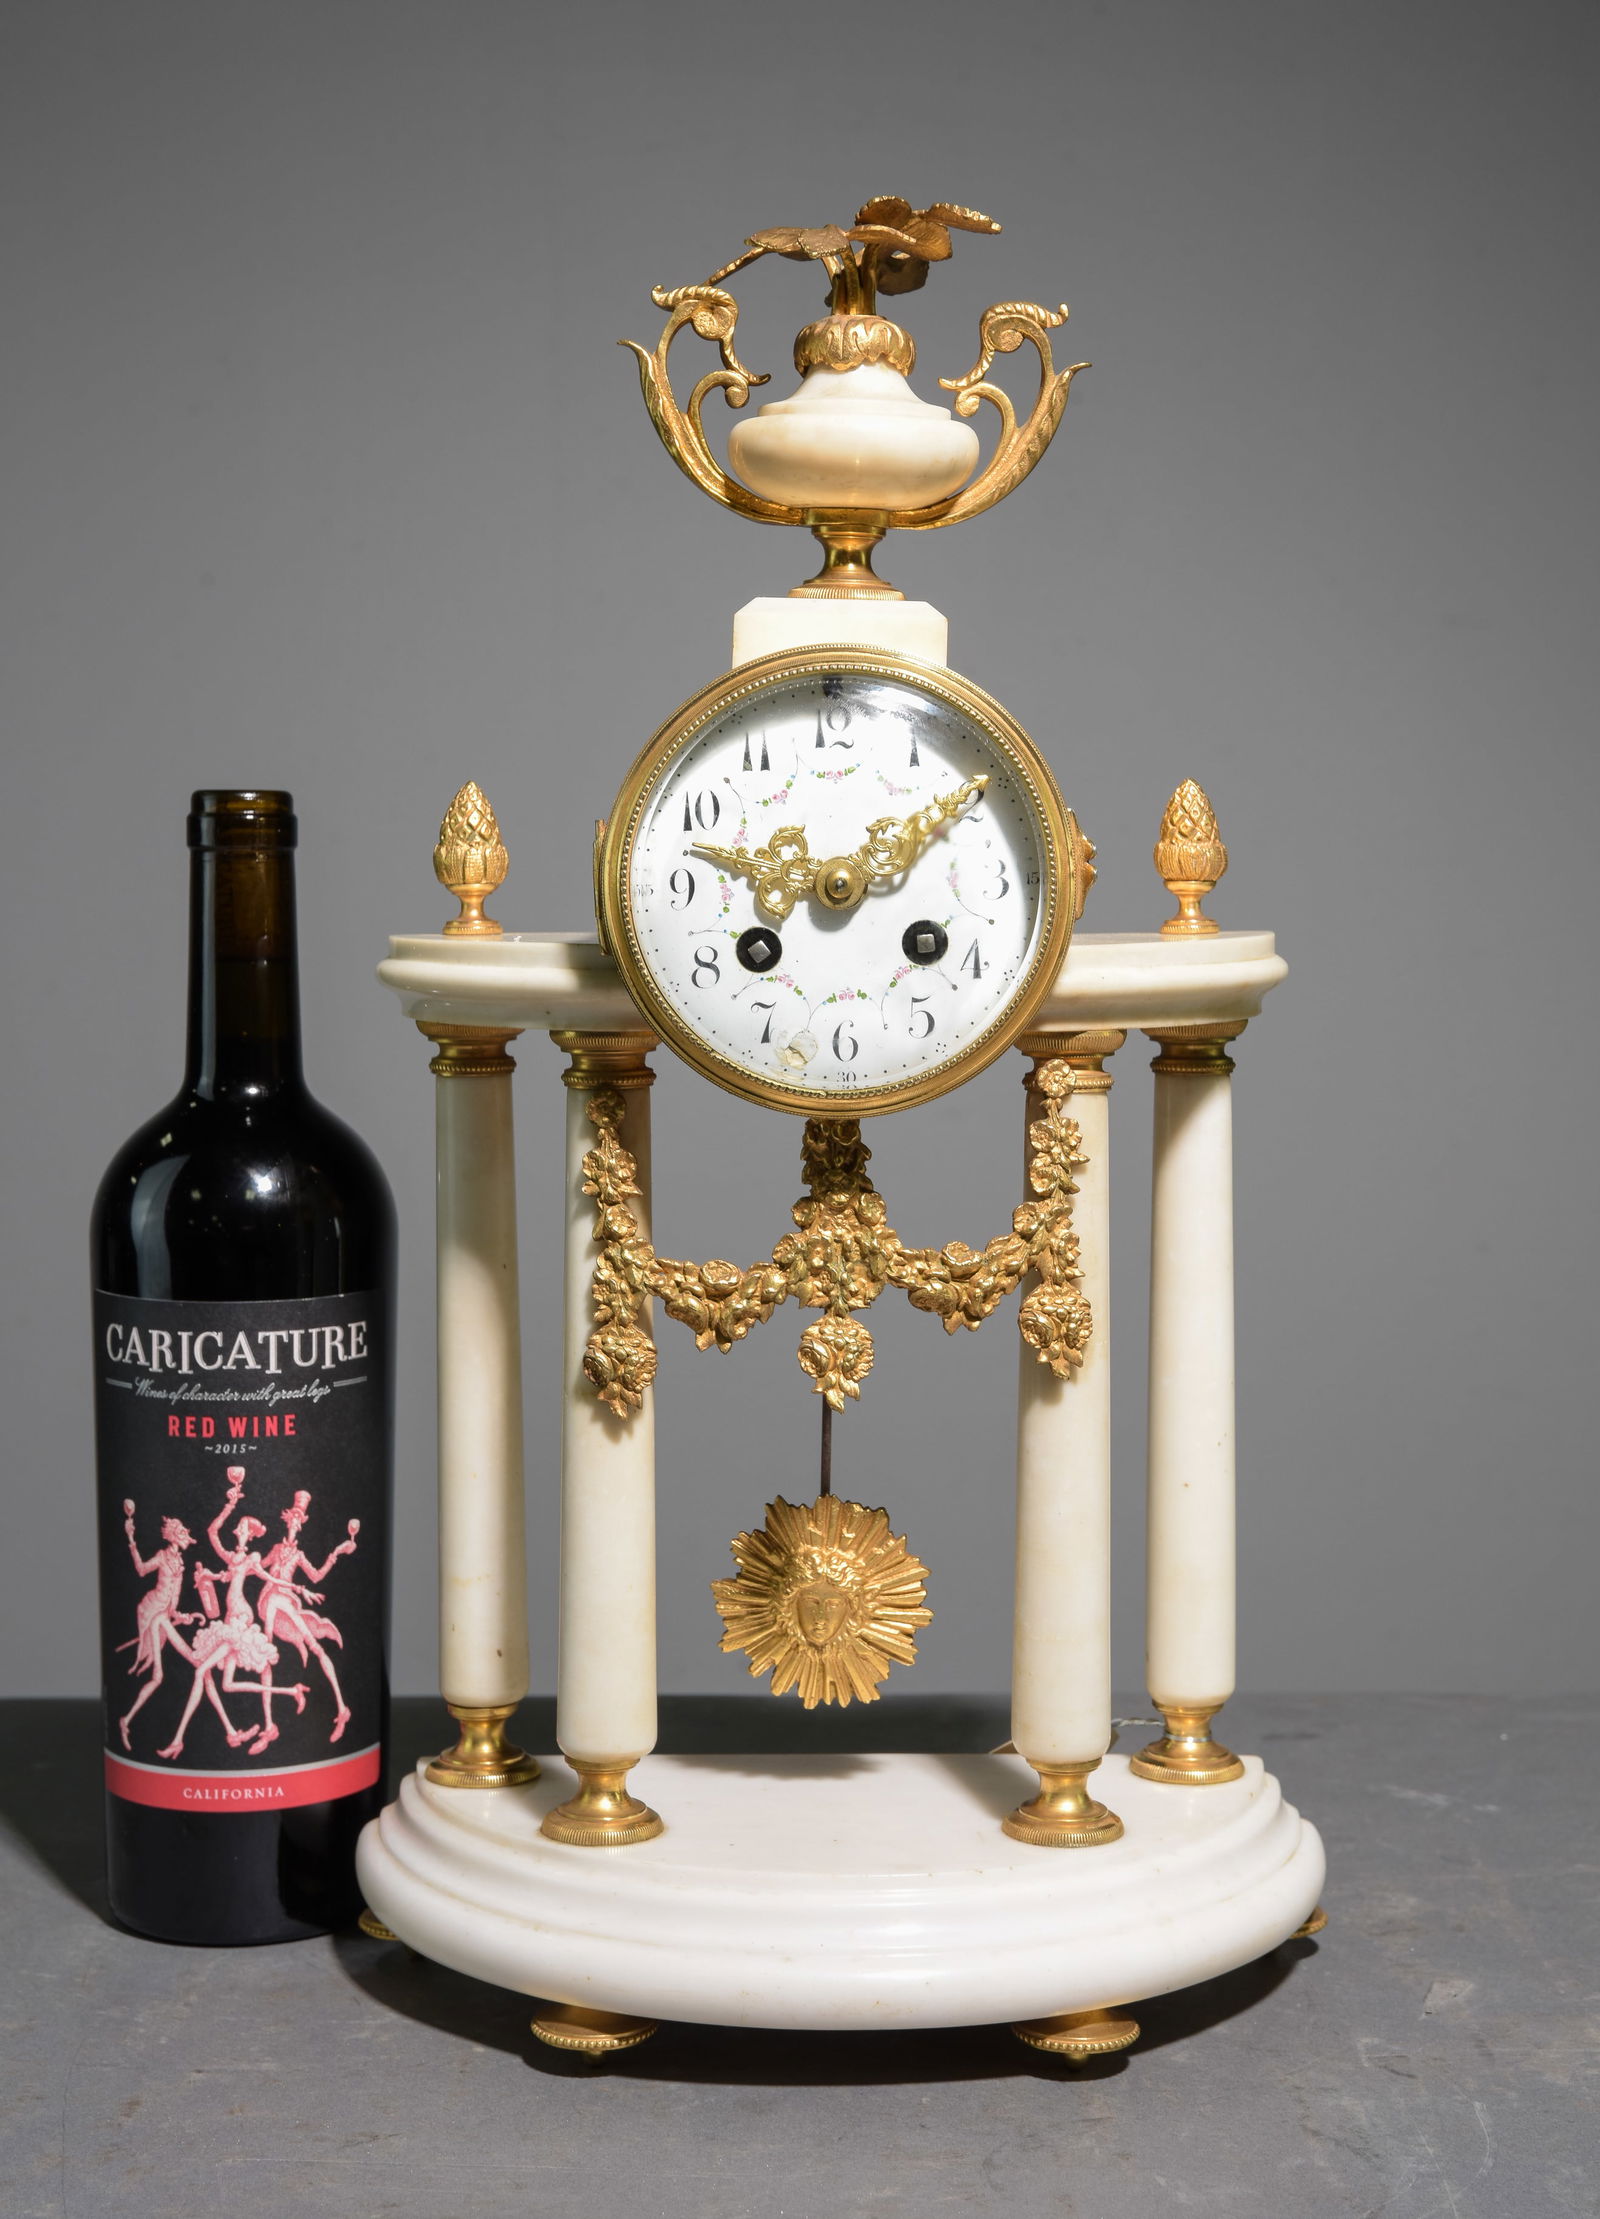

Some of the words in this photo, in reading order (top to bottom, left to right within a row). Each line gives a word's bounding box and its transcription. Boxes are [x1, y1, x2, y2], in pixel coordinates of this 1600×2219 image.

[816, 707, 854, 750] 12
[742, 730, 771, 772] 11
[682, 789, 720, 832] 10
[669, 868, 695, 911] 9
[982, 859, 1010, 900] 3
[1026, 872, 1041, 886] 15
[691, 945, 721, 989] 8
[960, 938, 989, 980] 4
[750, 1001, 777, 1044] 7
[908, 995, 936, 1039] 5
[832, 1020, 859, 1062] 6
[106, 1321, 368, 1375] CARICATURE
[135, 1377, 167, 1398] Wines
[168, 1383, 188, 1406] of
[182, 1383, 240, 1401] character
[241, 1382, 275, 1401] with
[268, 1389, 308, 1407] great
[307, 1379, 331, 1403] legs
[168, 1415, 216, 1438] RED
[228, 1414, 297, 1437] WINE
[183, 1786, 285, 1799] CALIFORNIA
